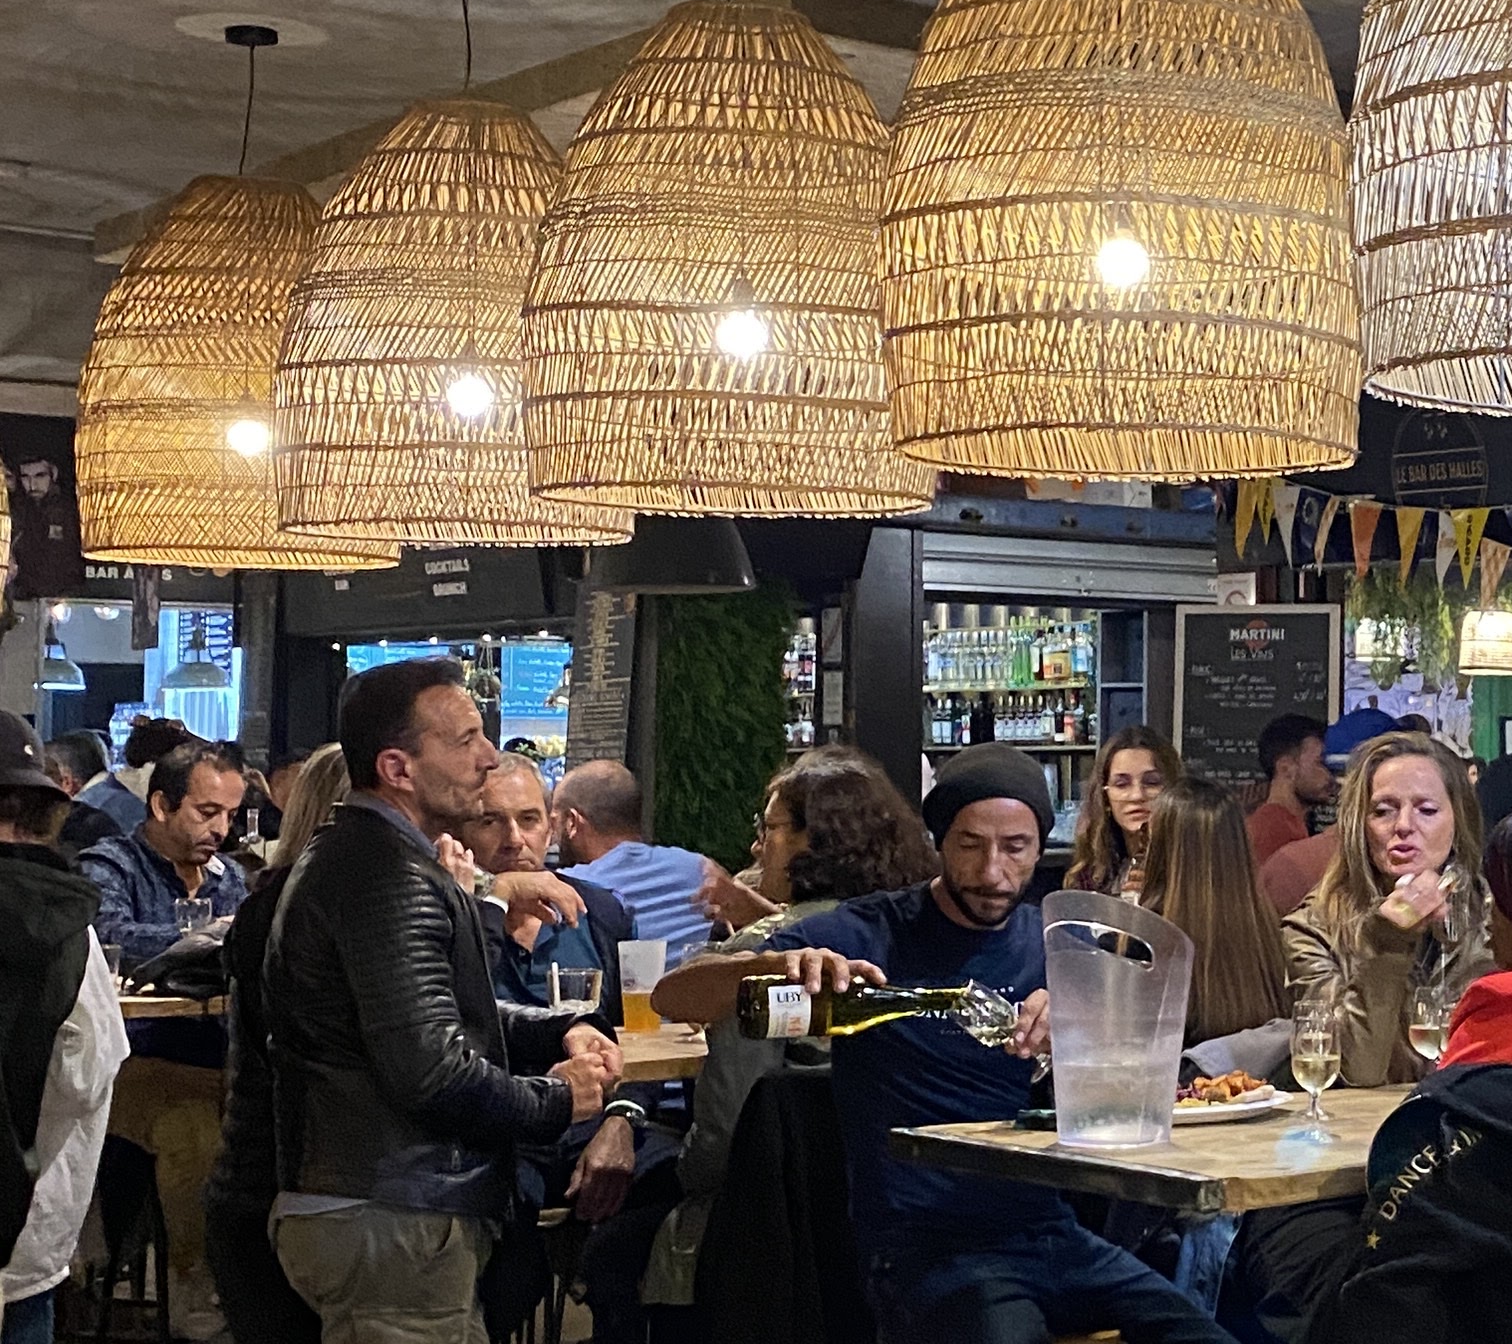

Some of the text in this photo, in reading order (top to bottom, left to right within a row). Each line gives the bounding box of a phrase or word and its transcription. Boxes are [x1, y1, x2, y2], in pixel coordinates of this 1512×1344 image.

[1408, 463, 1428, 482] BAR
[1429, 461, 1448, 481] DES
[1449, 458, 1485, 479] HALLES
[85, 565, 119, 579] BAR
[1230, 628, 1285, 641] MARTINI
[776, 991, 802, 1004] UBY
[1379, 1144, 1442, 1221] DANCE
